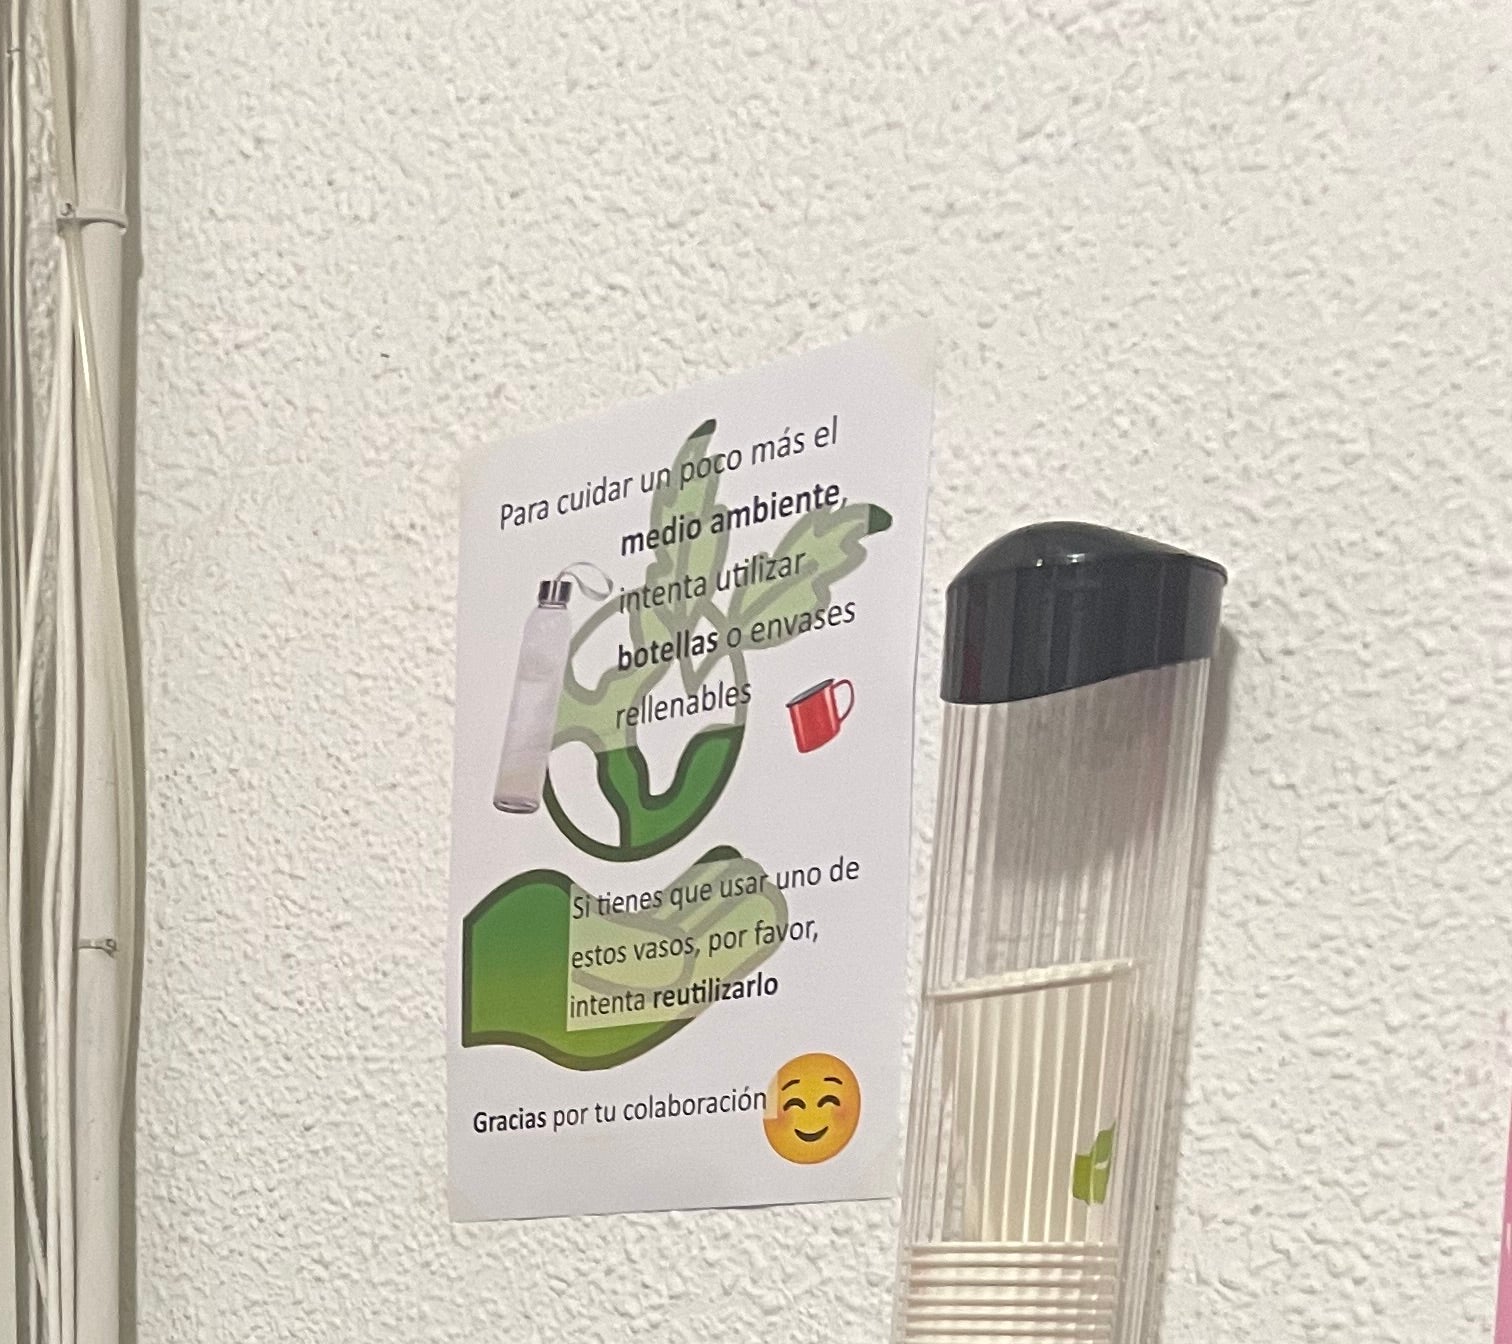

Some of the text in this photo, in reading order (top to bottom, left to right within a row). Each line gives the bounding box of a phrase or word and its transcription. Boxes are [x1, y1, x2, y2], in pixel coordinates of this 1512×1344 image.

[500, 415, 838, 530] Para cuidar un poco más el
[620, 480, 848, 557] medio ambiente,
[619, 550, 807, 614] intenta utilizar
[617, 598, 857, 671] botellas o envases
[615, 679, 752, 729] rellenables
[572, 855, 860, 920] Si tienes que usar uno de
[571, 915, 819, 969] estos vasos, por favor,
[569, 971, 779, 1020] intenta reutilizarlo
[473, 1086, 767, 1134] Gracias por tu colaboración
